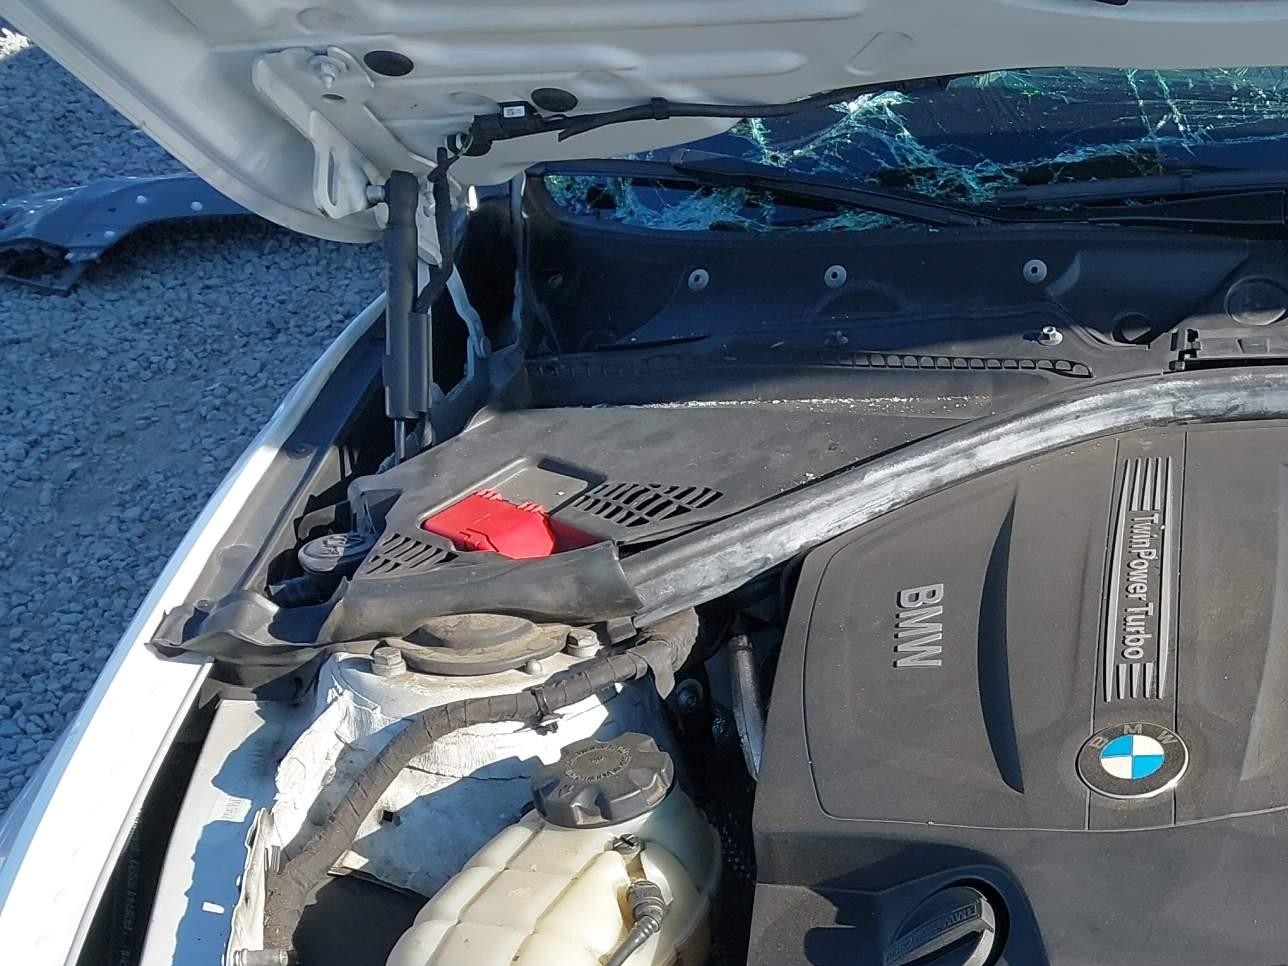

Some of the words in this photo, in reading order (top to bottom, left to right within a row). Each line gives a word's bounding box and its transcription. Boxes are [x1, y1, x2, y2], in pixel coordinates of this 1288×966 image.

[1126, 513, 1159, 601] TwinPower
[896, 584, 944, 667] BMW
[1122, 602, 1154, 660] Turbo
[1090, 723, 1178, 749] BMW
